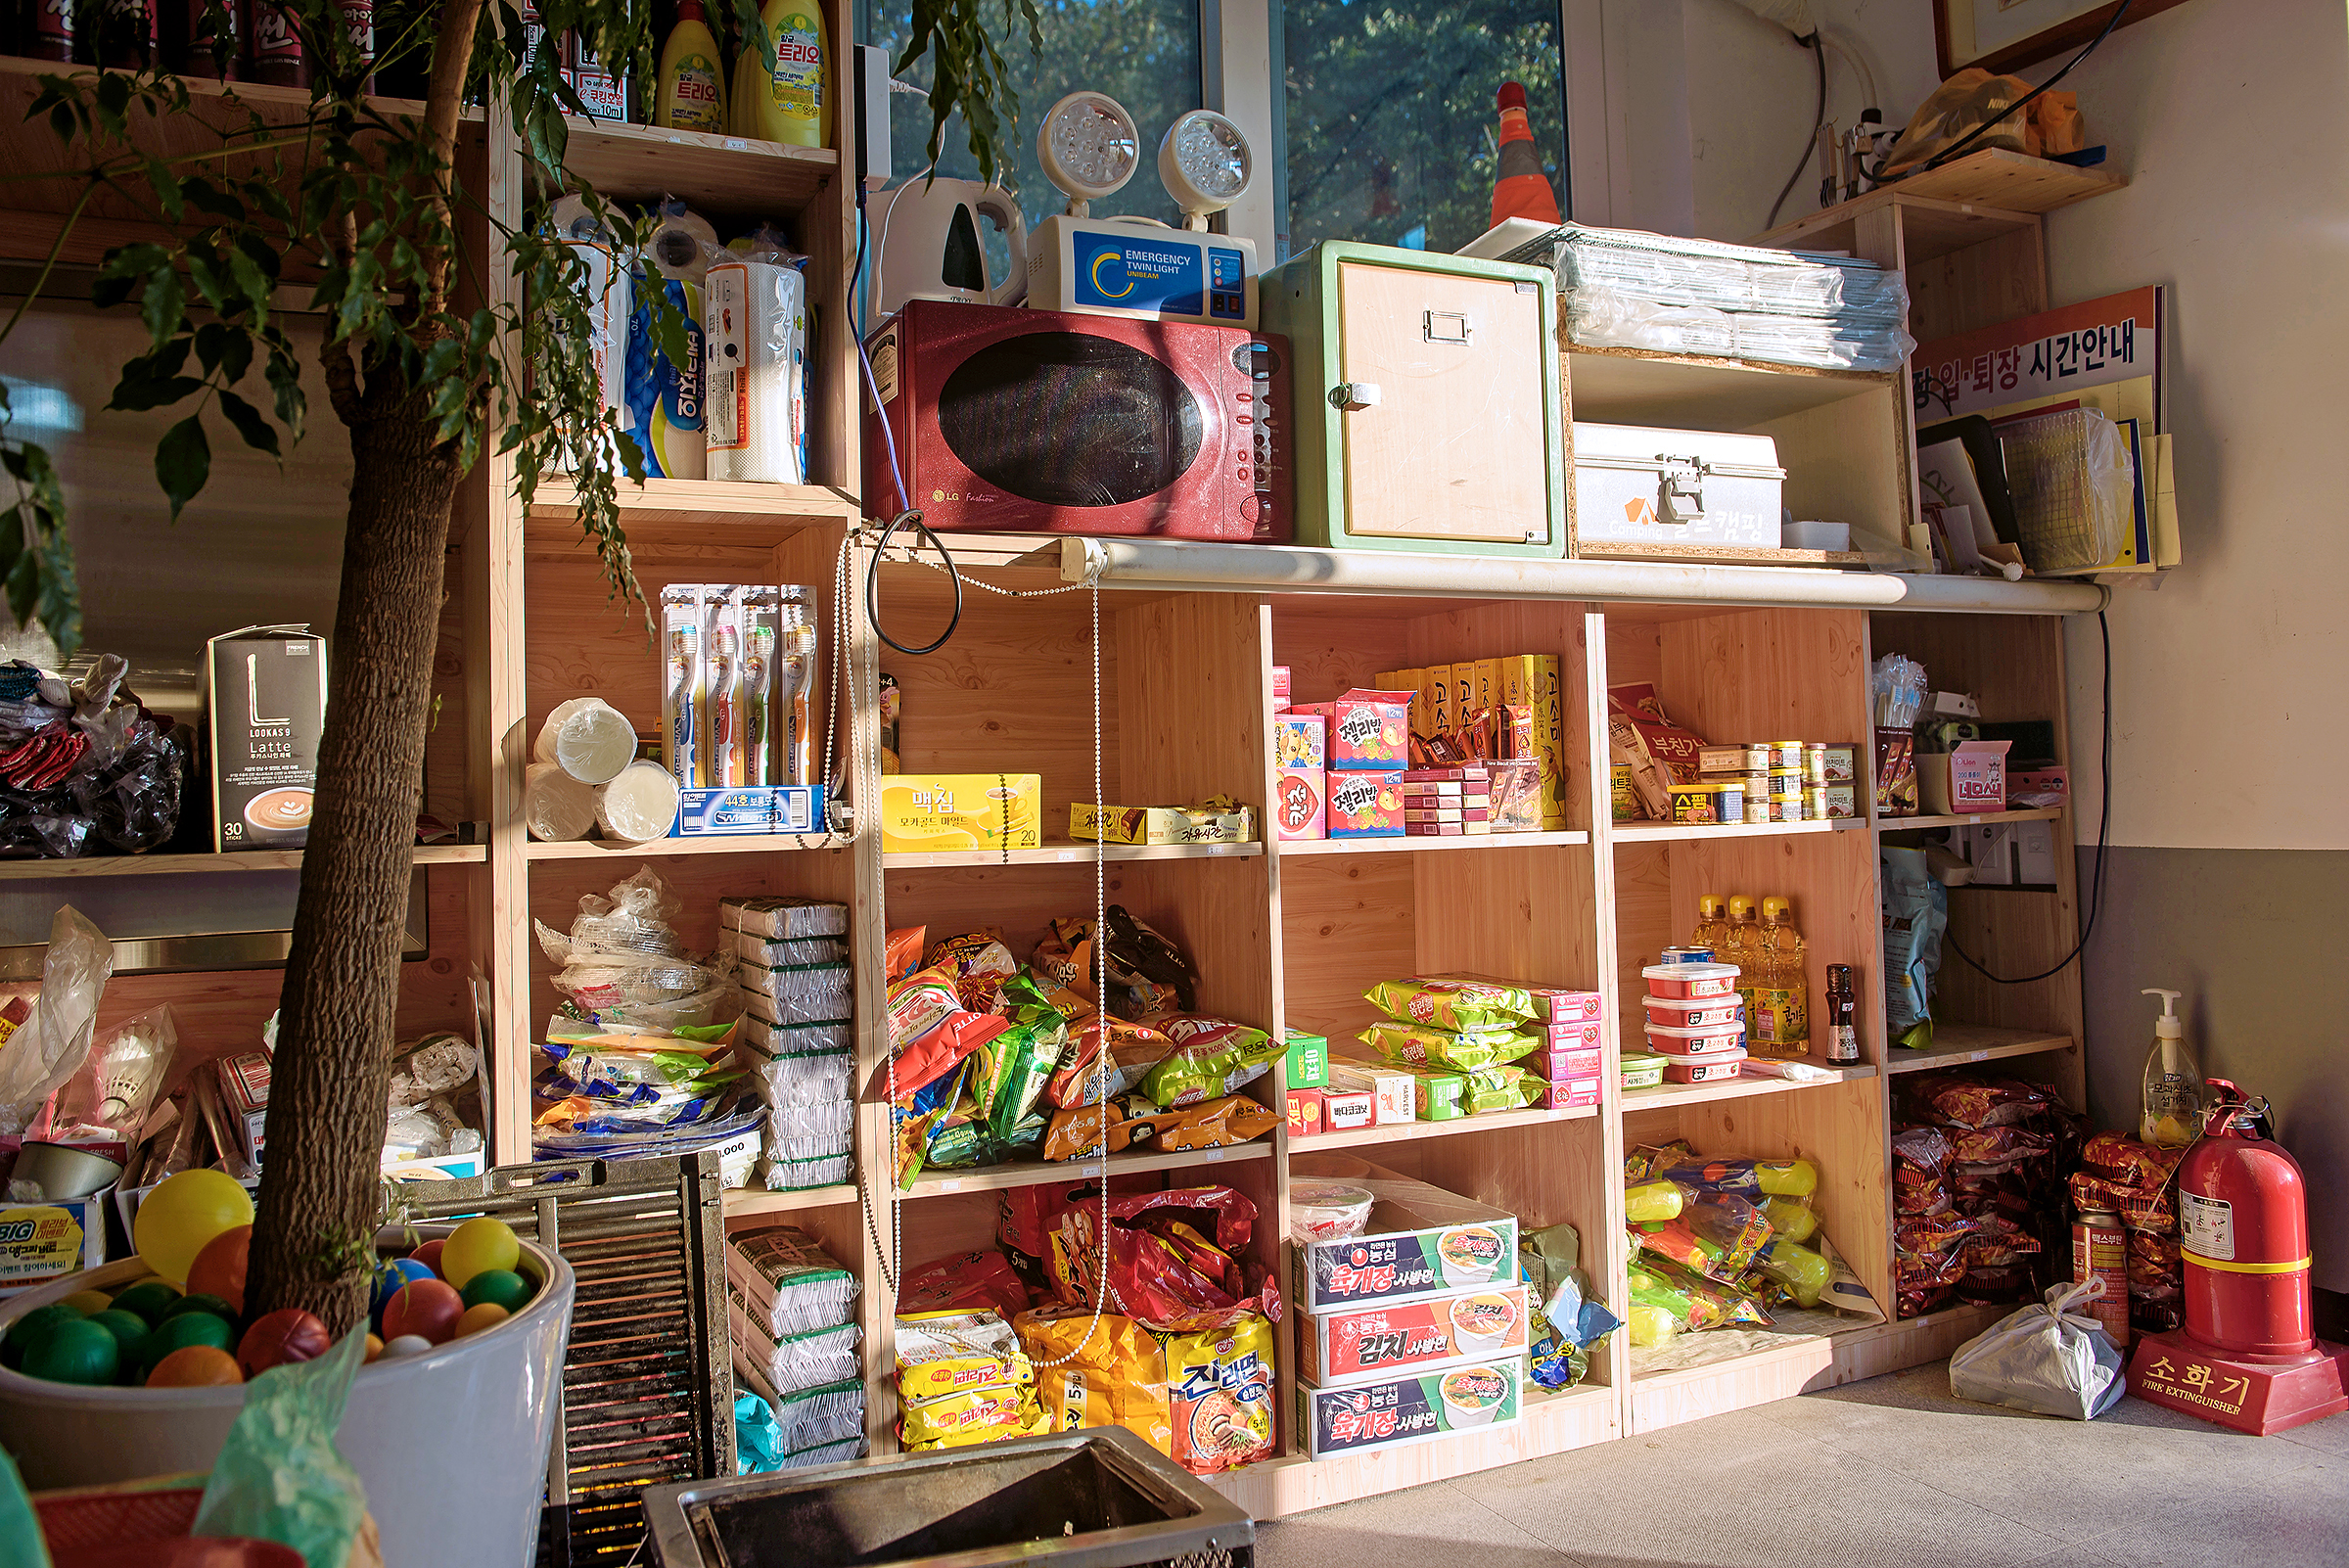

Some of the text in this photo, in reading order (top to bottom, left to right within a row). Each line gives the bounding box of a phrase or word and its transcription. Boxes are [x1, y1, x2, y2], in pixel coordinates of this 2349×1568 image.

[778, 44, 820, 65] 트리오
[677, 82, 716, 103] 트리오
[601, 105, 620, 117] 10m
[1126, 250, 1191, 266] EMERGENCY
[1127, 261, 1180, 274] TWIN LIGHT
[1127, 270, 1160, 279] UNIBEAM
[1939, 346, 2021, 401] 입·퇴장
[2029, 317, 2135, 382] 시간안내
[945, 492, 994, 503] LG Fashion
[1609, 521, 1663, 540] Camping
[1674, 511, 1763, 542] 드캠핑
[1435, 682, 1449, 730] 고소
[1459, 679, 1473, 728] 고소
[1546, 671, 1561, 743] 고소미
[249, 727, 291, 738] LOOKAS 9
[1338, 717, 1382, 742] 젤리밥
[1517, 725, 1533, 735] 쿠키
[250, 741, 292, 754] Latte
[1517, 749, 1533, 759] 초코
[1652, 736, 1708, 758] 부침가
[724, 795, 750, 807] 44호
[911, 784, 955, 814] 맥심
[1333, 786, 1378, 812] 젤리밥
[1675, 794, 1708, 810] 스팸
[224, 822, 243, 836] 30
[899, 816, 969, 828] 모카골드 마일드
[1021, 830, 1036, 842] 20
[1181, 826, 1224, 842] 자유시간
[1408, 994, 1434, 1018] 홈런볼
[1782, 1004, 1806, 1027] 콩기름
[1243, 1040, 1267, 1056] 농심
[1401, 1041, 1426, 1062] 홈런볼
[1305, 1048, 1320, 1082] 야채
[2153, 1084, 2192, 1095] 모과식초
[2160, 1095, 2188, 1107] 설거지
[1235, 1105, 1257, 1118] 농심
[717, 1140, 746, 1158] ,000
[0, 1222, 35, 1241] BIG
[2092, 1233, 2123, 1245] 맥스부탄
[9, 1244, 57, 1258] 앵그리 버드
[1453, 1236, 1496, 1252] 육개장
[1012, 1251, 1028, 1270] 5개입
[1369, 1248, 1397, 1263] 농심
[1328, 1264, 1436, 1296] 육개장 사발면
[1473, 1304, 1503, 1314] 김치
[1359, 1319, 1388, 1334] 농심
[1358, 1330, 1450, 1365] 김치 사발면
[954, 1363, 998, 1386] 진라면
[1182, 1350, 1260, 1402] 진라면
[2145, 1356, 2250, 1407] 소화기
[1069, 1374, 1082, 1400] 5개입
[1456, 1376, 1500, 1390] 육개장
[1242, 1385, 1264, 1400] 순한맛
[1370, 1392, 1399, 1408] 농심
[2142, 1379, 2241, 1415] FIRE EXTINGUISHER
[960, 1399, 1000, 1427] 진라면
[1253, 1418, 1267, 1428] 5+1
[1331, 1407, 1439, 1444] 육개장 사발면
